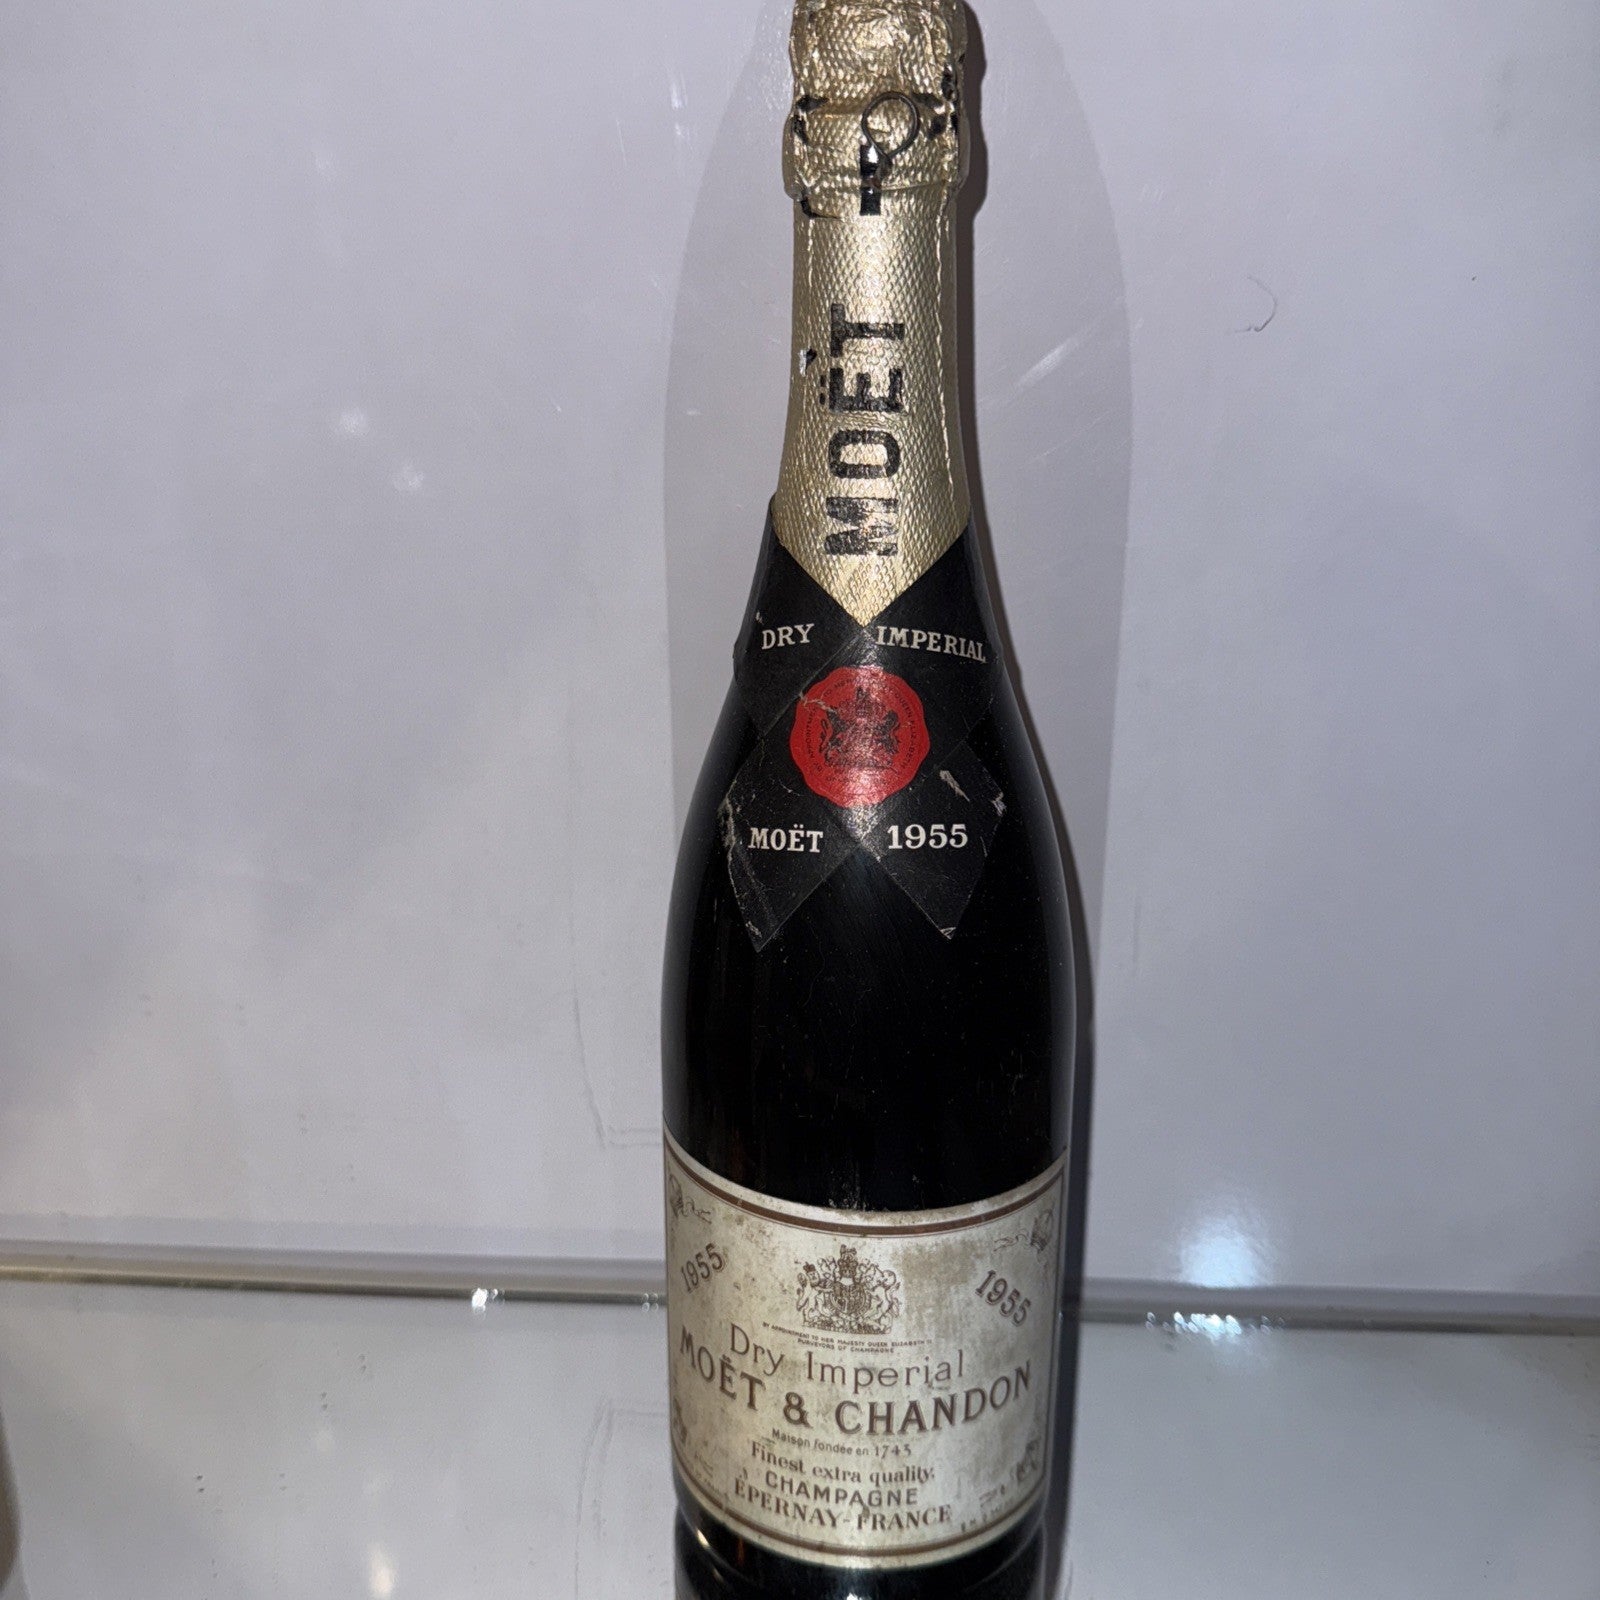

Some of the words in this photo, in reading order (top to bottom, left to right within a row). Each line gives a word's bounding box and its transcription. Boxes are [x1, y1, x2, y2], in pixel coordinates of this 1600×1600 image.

[819, 303, 905, 557] MOËT
[762, 624, 814, 650] DRY
[875, 625, 987, 663] IMPERIAL
[748, 823, 823, 853] MOËT
[887, 823, 968, 850] 1955
[681, 1243, 725, 1293] 1955
[975, 1269, 1031, 1327] 1955
[680, 1325, 766, 1411] MOËT
[783, 1391, 813, 1429] &
[835, 1358, 1031, 1436] CHANDON
[730, 1323, 785, 1377] Dry
[806, 1349, 963, 1394] Imperial
[751, 1441, 806, 1475] Finest
[812, 1464, 862, 1483] extra
[771, 1428, 811, 1448] Maison
[856, 1447, 869, 1456] en
[765, 1470, 918, 1508] CHAMPAGNE
